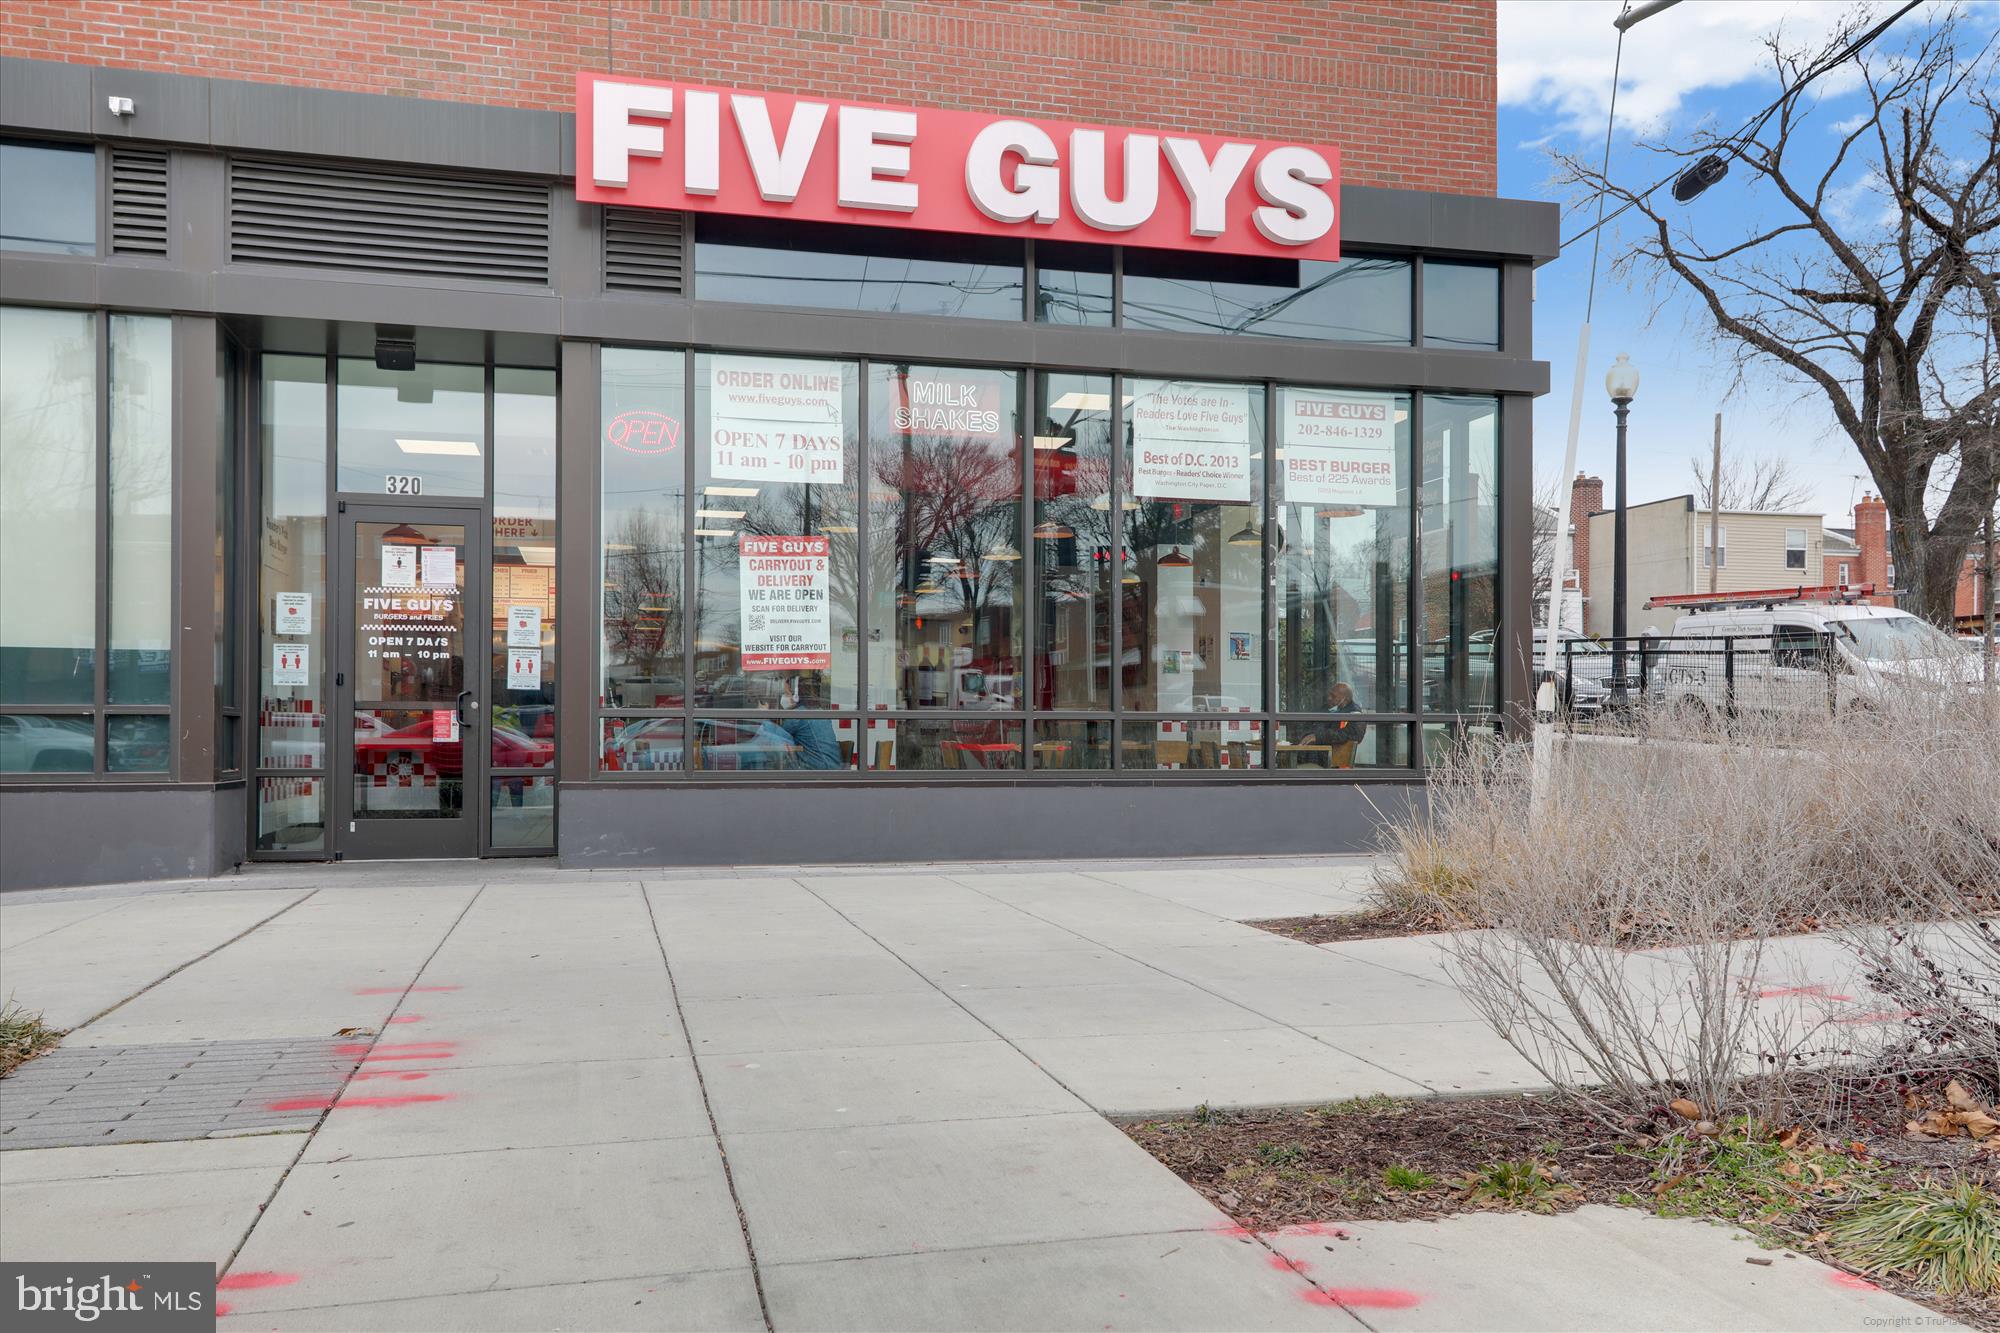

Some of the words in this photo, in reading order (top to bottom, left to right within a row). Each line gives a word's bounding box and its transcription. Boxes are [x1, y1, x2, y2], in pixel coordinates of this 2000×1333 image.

[593, 80, 918, 213] FIVE
[965, 120, 1335, 246] GUYS
[716, 370, 774, 388] ORDER
[780, 373, 840, 393] ONLINE
[728, 393, 828, 406] www.fiveguys.com
[913, 381, 977, 407] MILK
[1171, 394, 1198, 406] Votes
[1201, 398, 1217, 407] are
[1136, 408, 1175, 420] Readers
[1177, 410, 1198, 421] Love
[1200, 411, 1219, 422] Five
[1296, 401, 1333, 416] FIVE
[1338, 404, 1384, 419] GUYS
[895, 407, 999, 433] SHAKES
[608, 419, 680, 446] OPEN
[1298, 423, 1383, 438] 202-846-1329
[714, 429, 768, 449] OPEN
[775, 433, 786, 449] 7
[792, 433, 840, 451] DAYS
[717, 451, 733, 466] 11
[740, 456, 767, 468] am
[787, 453, 804, 470] 10
[811, 457, 837, 474] pm
[1143, 451, 1168, 465] Best
[1171, 453, 1183, 465] of
[1185, 453, 1208, 467] D.C.
[1210, 455, 1239, 468] 2013
[1289, 459, 1327, 472] BEST
[1330, 461, 1391, 474] BURGER
[1202, 470, 1222, 479] Choice
[1289, 472, 1313, 482] Best
[1316, 474, 1326, 483] of
[1328, 473, 1349, 484] 225
[1352, 475, 1391, 486] Awards
[388, 476, 421, 494] 320
[494, 517, 534, 526] RDER
[495, 528, 526, 537] HERE
[744, 541, 778, 552] FIVE
[782, 541, 824, 552] GUYS
[749, 559, 812, 571] CARRYOUT
[816, 559, 824, 571] &
[757, 575, 814, 586] DELIVERY
[748, 589, 766, 600] WE
[769, 589, 791, 600] ARE
[795, 589, 823, 600] OPEN
[364, 598, 401, 610] FIVE
[407, 598, 453, 611] GUYS
[752, 605, 770, 613] SCAN
[368, 636, 403, 646] OPEN
[406, 637, 413, 646] 7
[417, 637, 449, 646] DAYS
[745, 644, 774, 652] WEBSITE
[791, 643, 827, 651] CARRYOUT
[368, 650, 377, 658] 11
[432, 651, 450, 660] pm
[746, 657, 826, 665] www.FIVEGUYS.com
